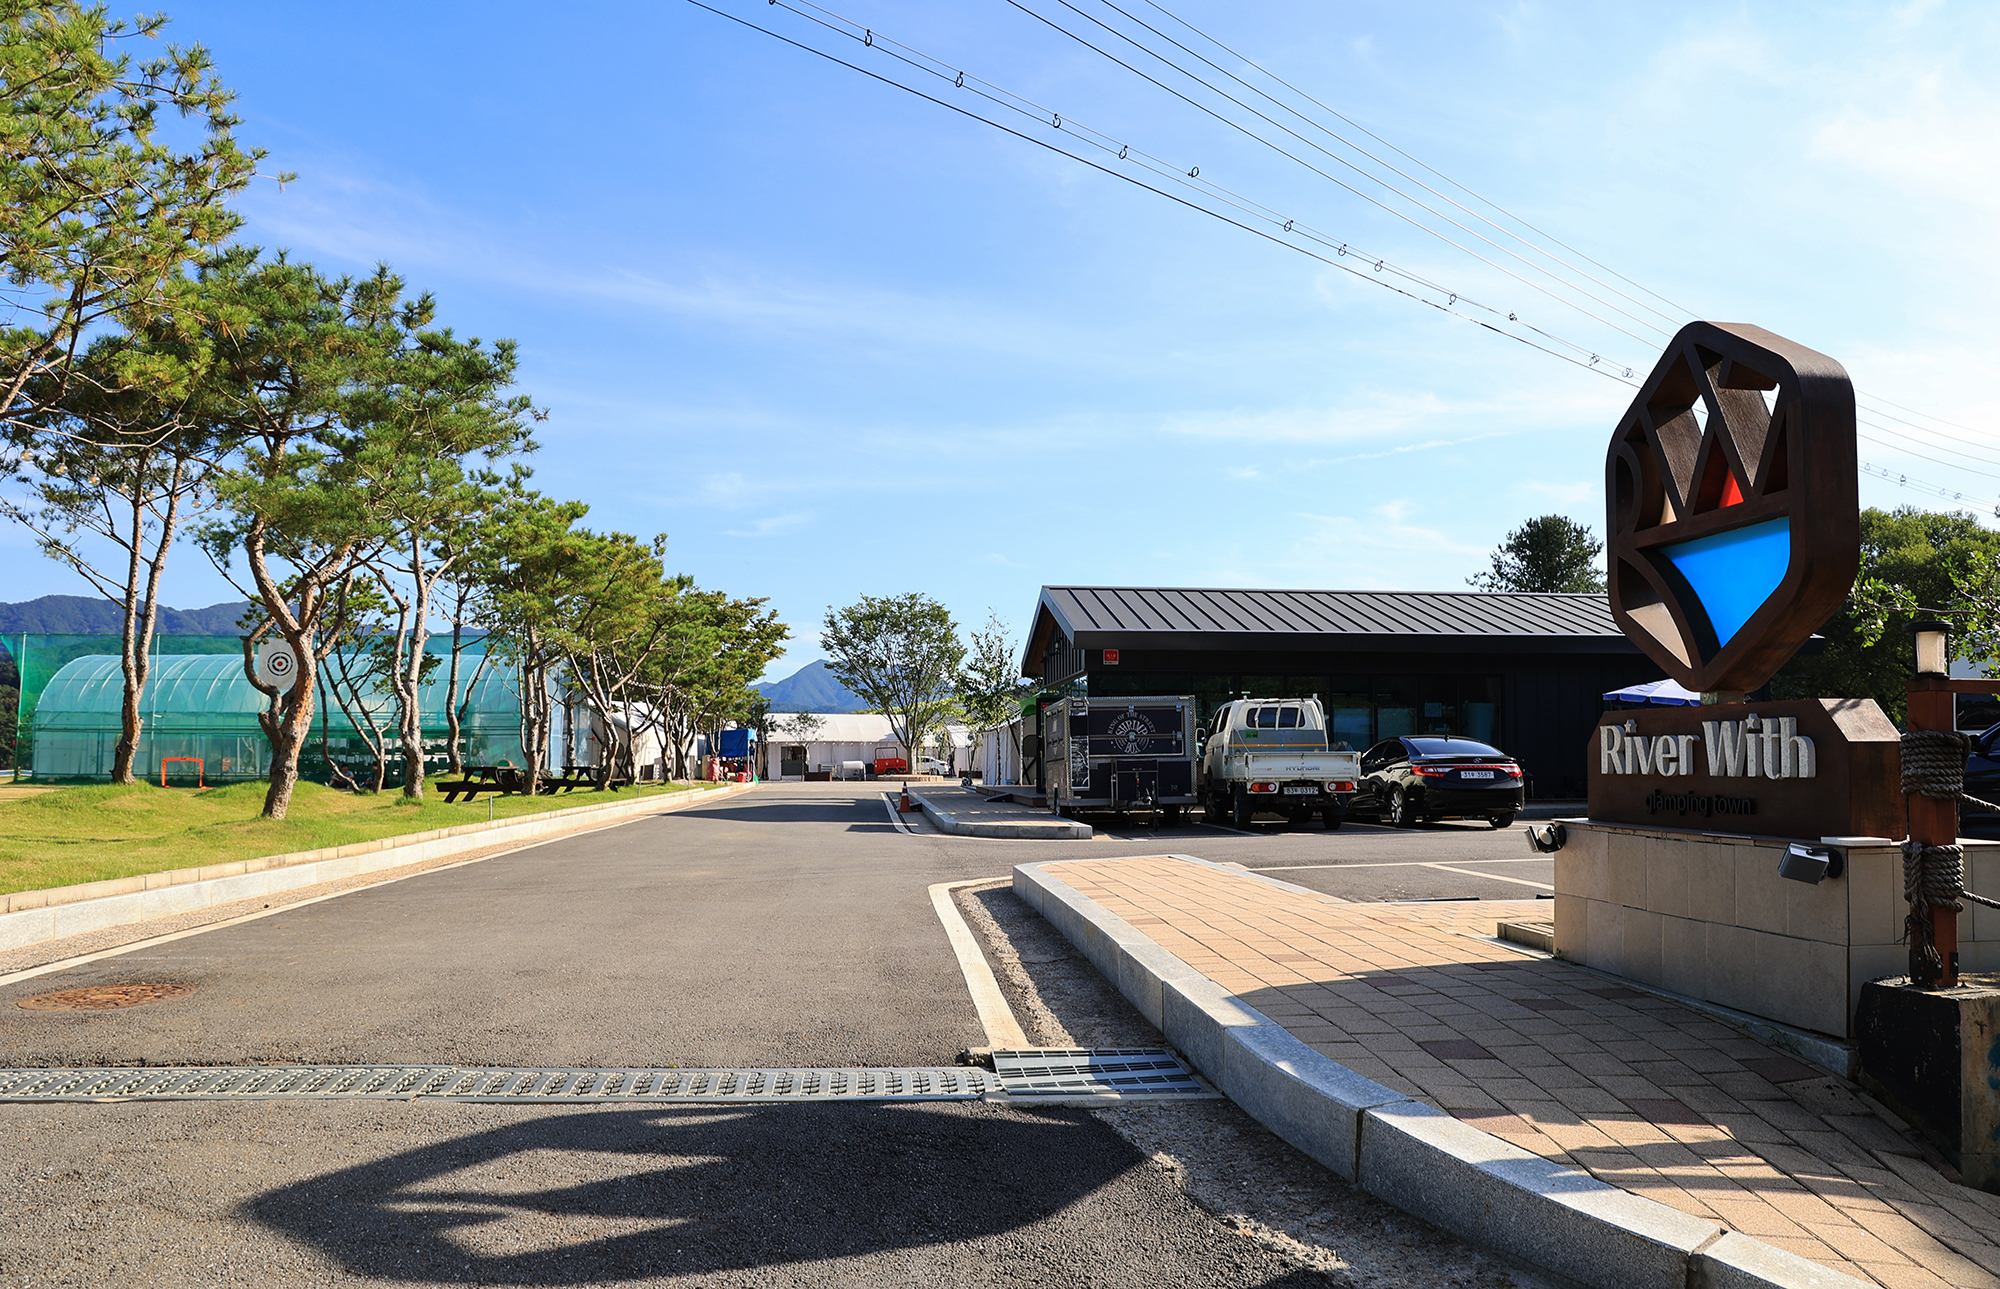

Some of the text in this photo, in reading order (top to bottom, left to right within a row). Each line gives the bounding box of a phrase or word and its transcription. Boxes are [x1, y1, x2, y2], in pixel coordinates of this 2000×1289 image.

[1115, 720, 1148, 736] SHRIMP
[1139, 714, 1156, 733] STREET
[1124, 742, 1140, 754] BOX
[1600, 713, 1816, 780] River With
[1644, 788, 1755, 818] glamping town
